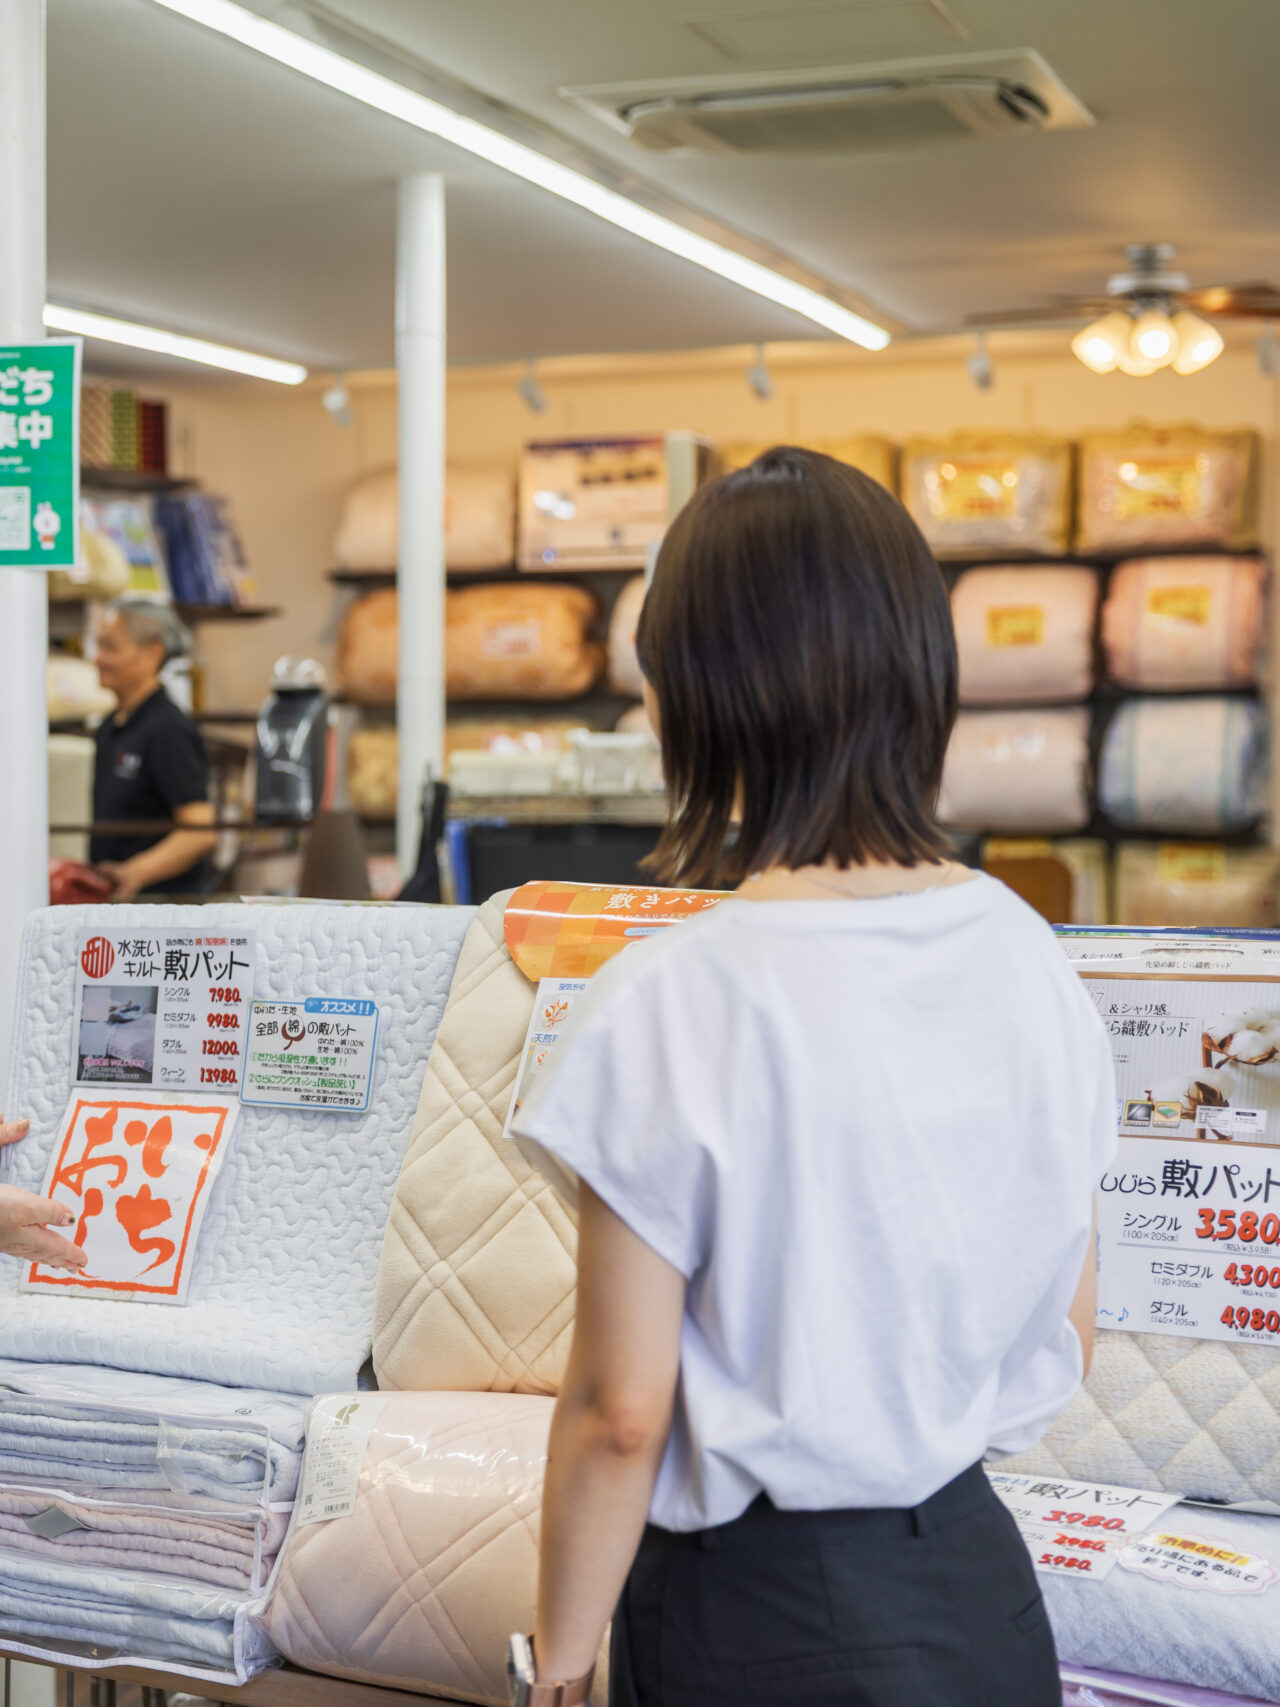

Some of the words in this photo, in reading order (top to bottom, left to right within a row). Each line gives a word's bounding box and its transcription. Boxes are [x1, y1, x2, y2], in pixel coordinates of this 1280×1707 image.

[118, 939, 161, 958] 水洗い
[123, 960, 162, 978] キルト
[163, 949, 250, 981] 敷パット
[255, 1021, 279, 1037] 全部
[162, 1040, 182, 1049] ダブル
[1123, 1212, 1183, 1231] シングル
[1150, 1261, 1215, 1280] セミダブル
[1150, 1301, 1189, 1317] ダブル
[1024, 1482, 1163, 1508] 敷パット
